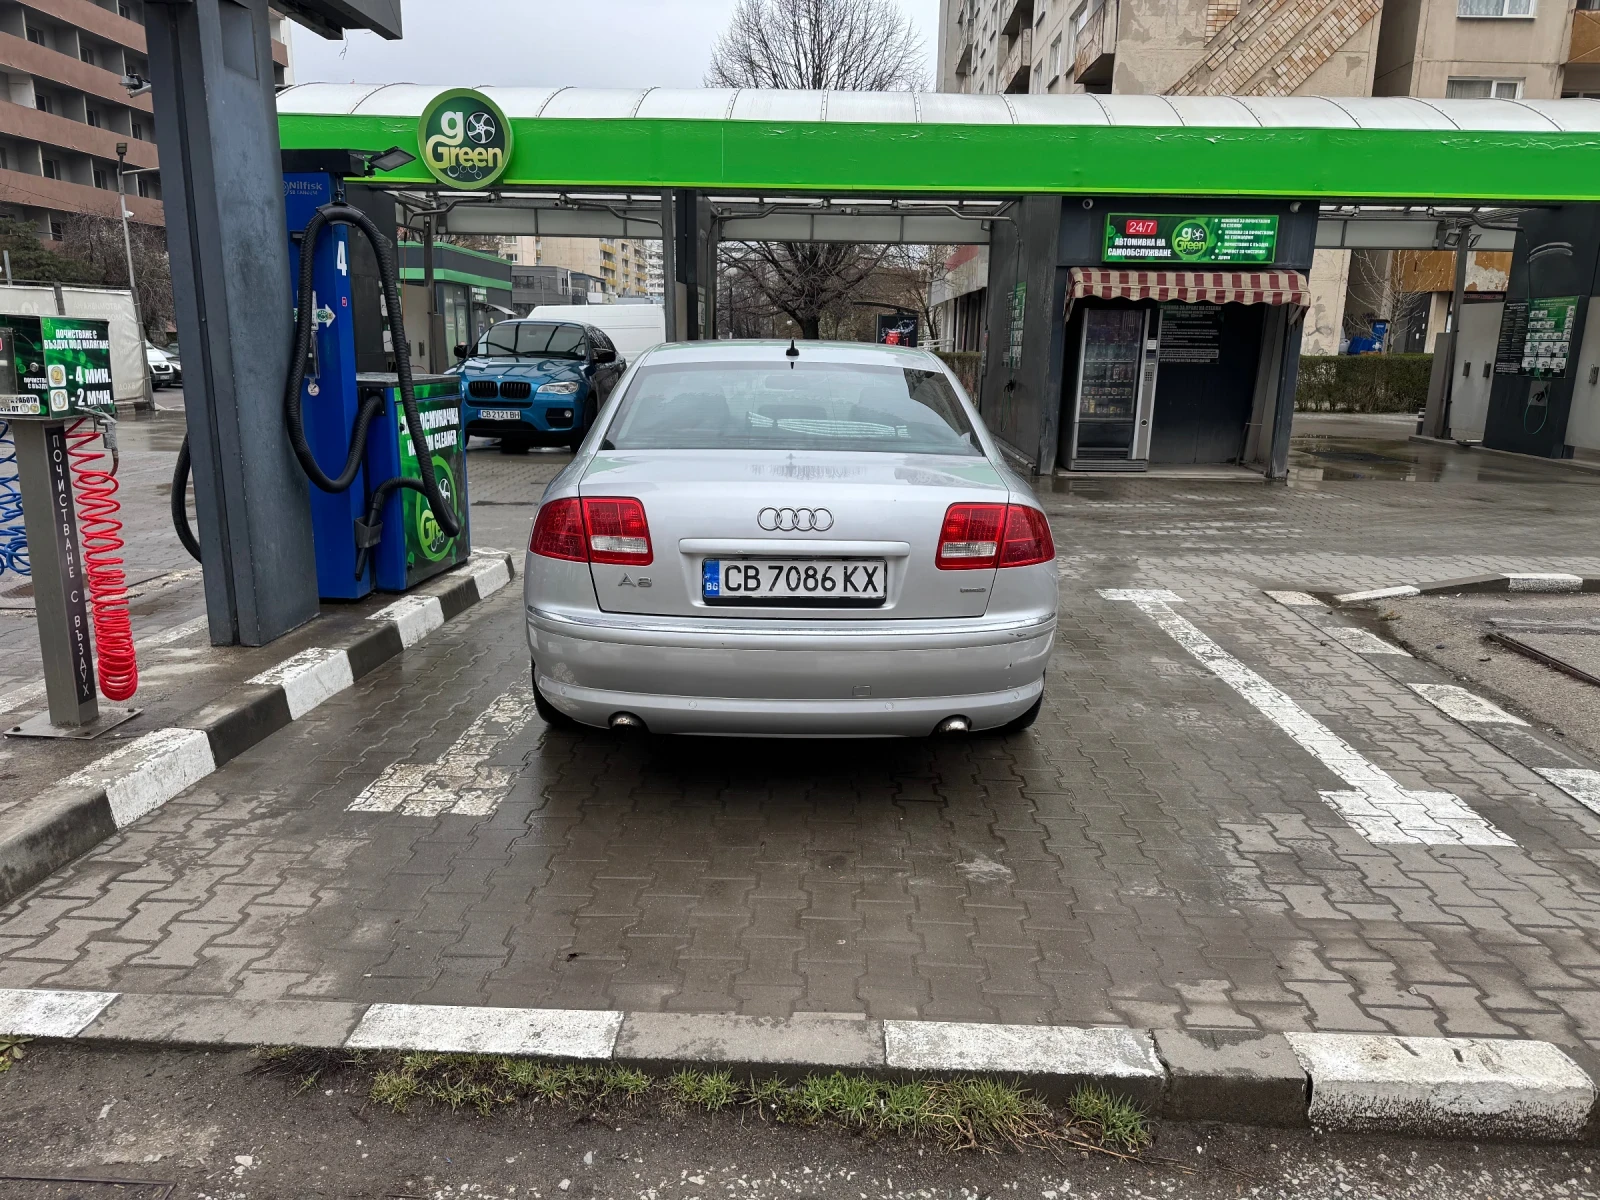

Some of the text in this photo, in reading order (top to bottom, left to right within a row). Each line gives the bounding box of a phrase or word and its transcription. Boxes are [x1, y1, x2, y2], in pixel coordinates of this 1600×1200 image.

[426, 135, 502, 169] Green
[289, 181, 322, 190] Nilfisk
[1129, 222, 1154, 233] 24/7
[1114, 238, 1166, 247] АВТОМИВКА НА
[1174, 237, 1205, 250] Green
[336, 241, 347, 277] 4
[1107, 248, 1171, 257] САМООБСЛУЖВАНЕ
[55, 329, 98, 339] ПОЧИСТВАНЕ С
[44, 340, 109, 350] ВЪЗДУХ ПОД НАЛЯГАНЕ
[75, 366, 84, 384] 4
[85, 368, 112, 384] МИН.
[77, 388, 85, 406] 2
[86, 390, 113, 405] МИН.
[492, 411, 508, 419] 2121
[434, 429, 457, 449] CLEANER
[53, 434, 90, 697] ПОЧИСТВАНЕ С ВЪЗДУХ
[617, 572, 652, 588] A8
[724, 565, 879, 593] CB 7086 KX
[706, 582, 718, 591] BG
